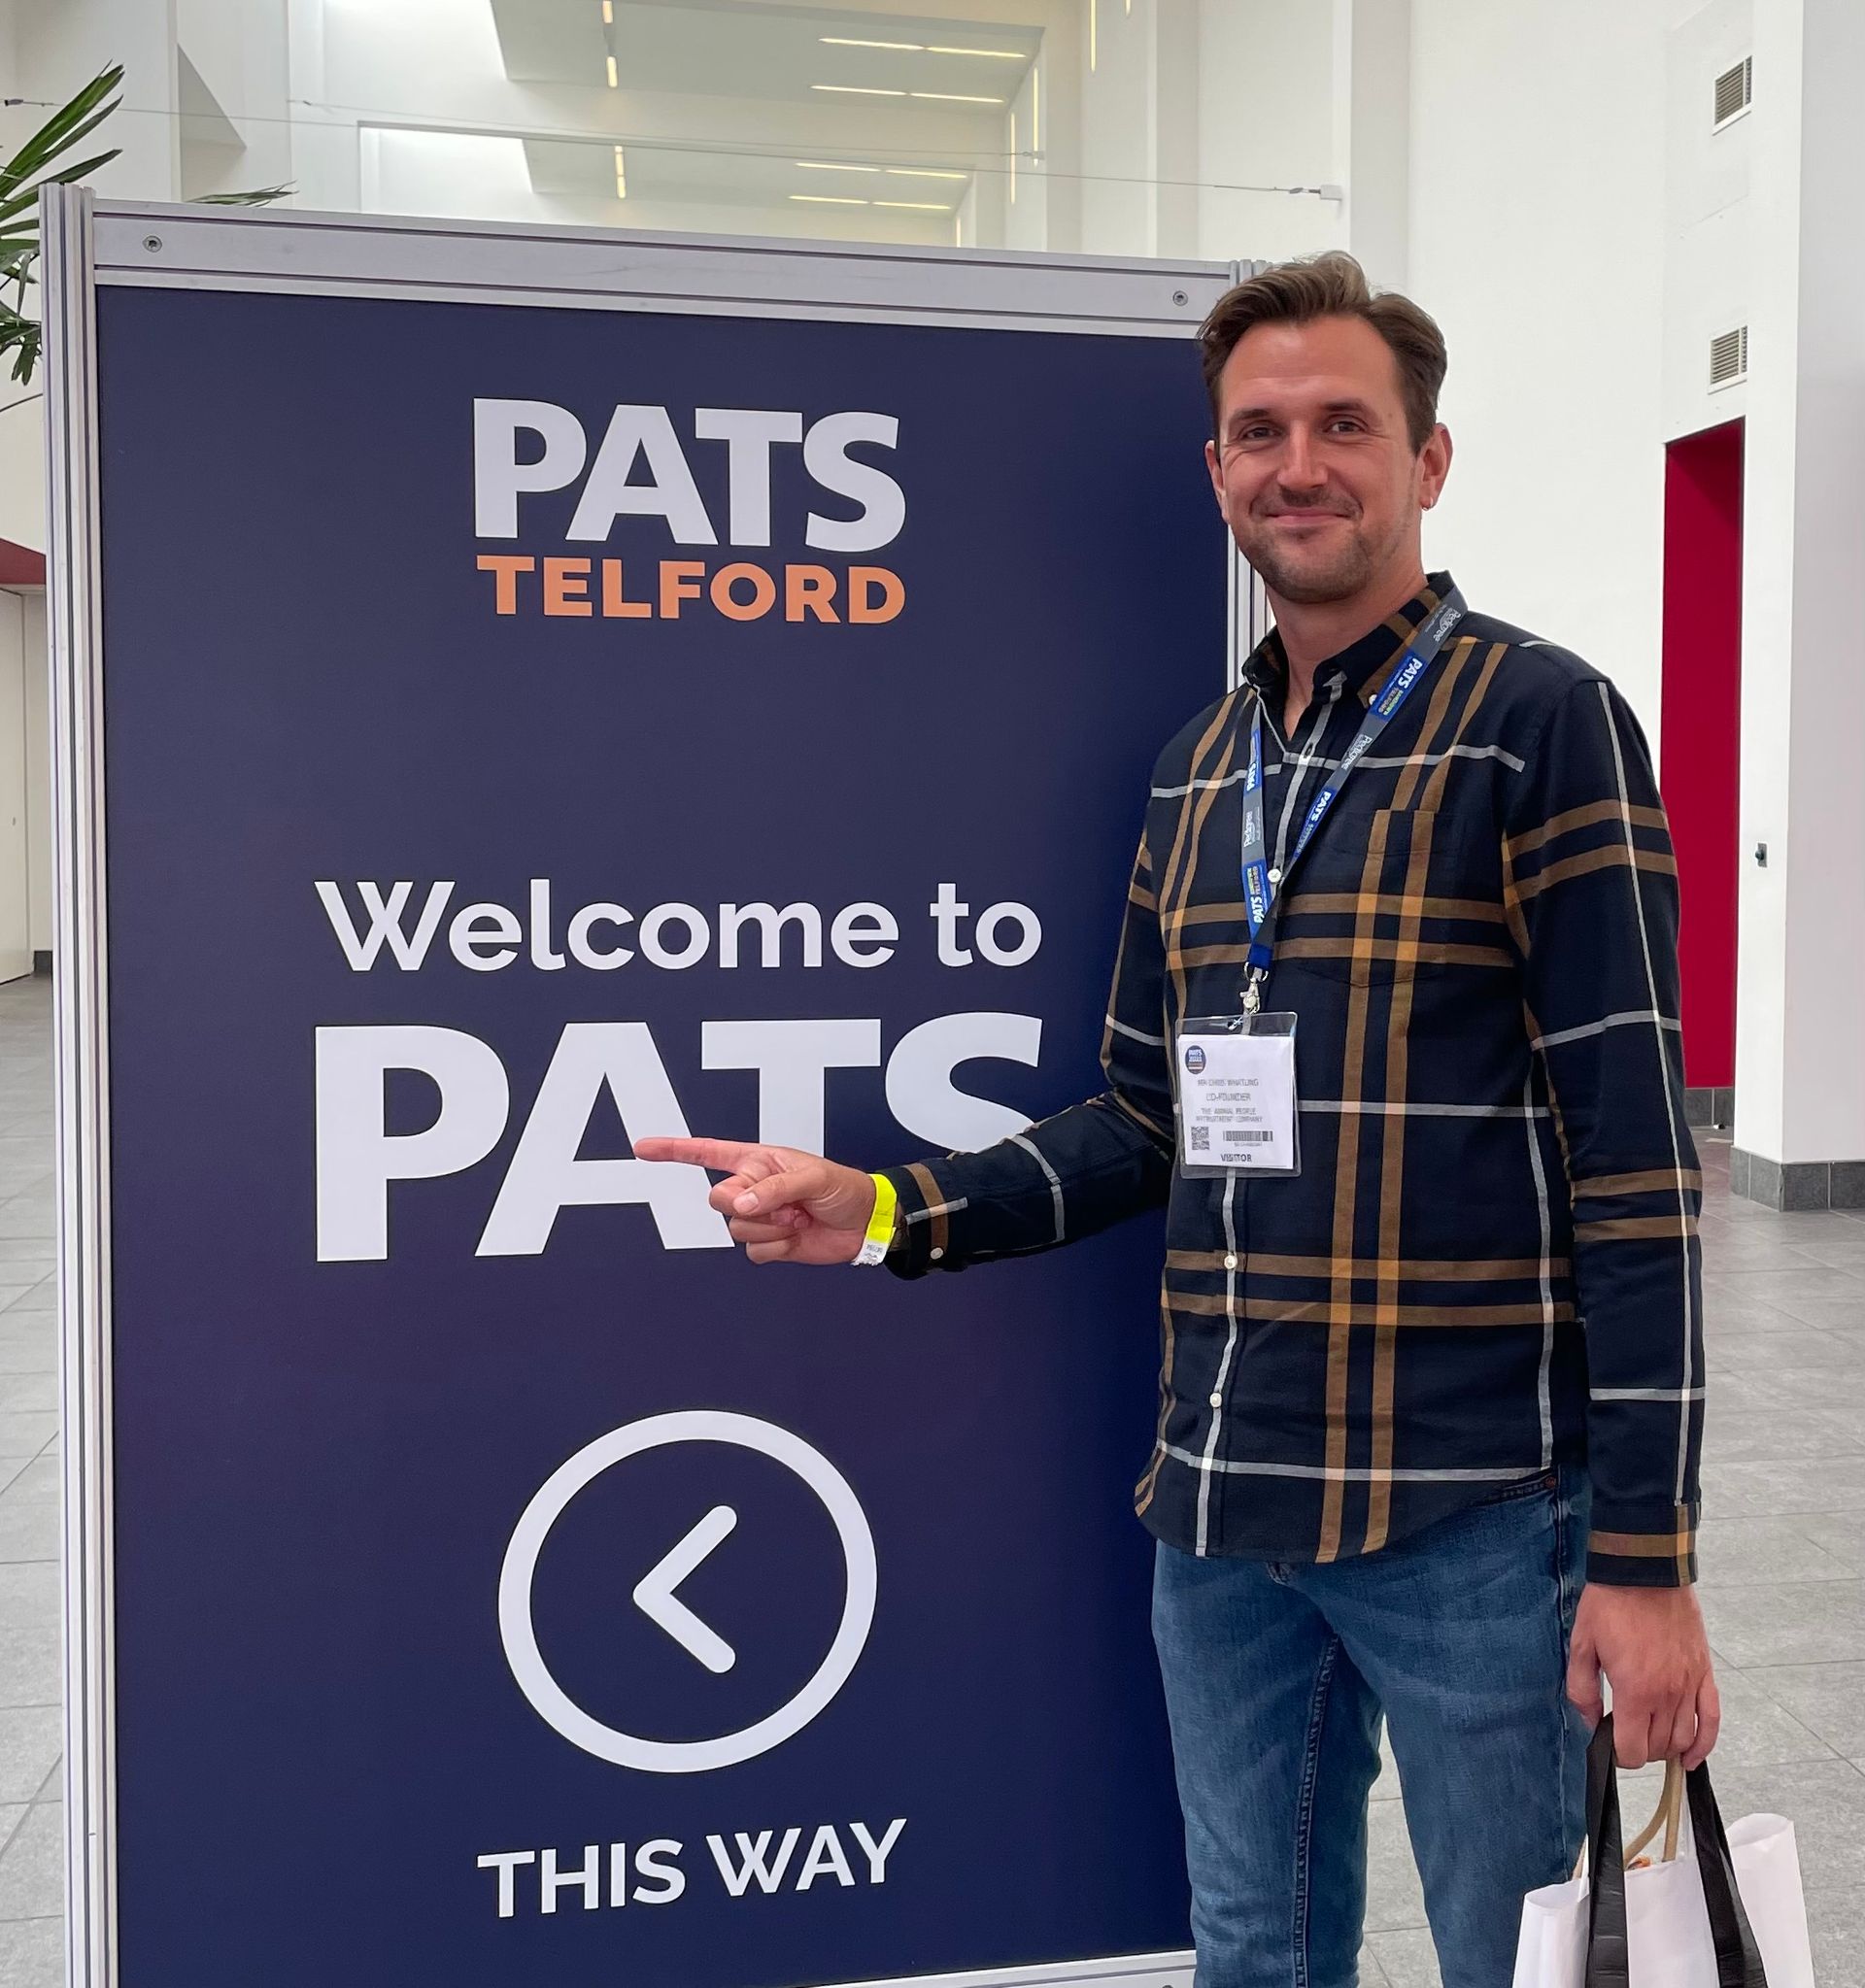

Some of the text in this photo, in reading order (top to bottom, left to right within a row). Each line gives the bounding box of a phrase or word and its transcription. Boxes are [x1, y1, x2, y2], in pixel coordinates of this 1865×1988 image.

[474, 398, 905, 555] PATS
[477, 556, 905, 625] TELFORD
[1398, 657, 1423, 689] PATS
[1310, 791, 1332, 823] PATS
[315, 879, 1041, 972] Welcome to
[1250, 897, 1265, 924] PATS
[316, 1013, 1042, 1263] PATS
[1220, 1153, 1252, 1162] VISITOR
[478, 1818, 907, 1918] THIS WAY
